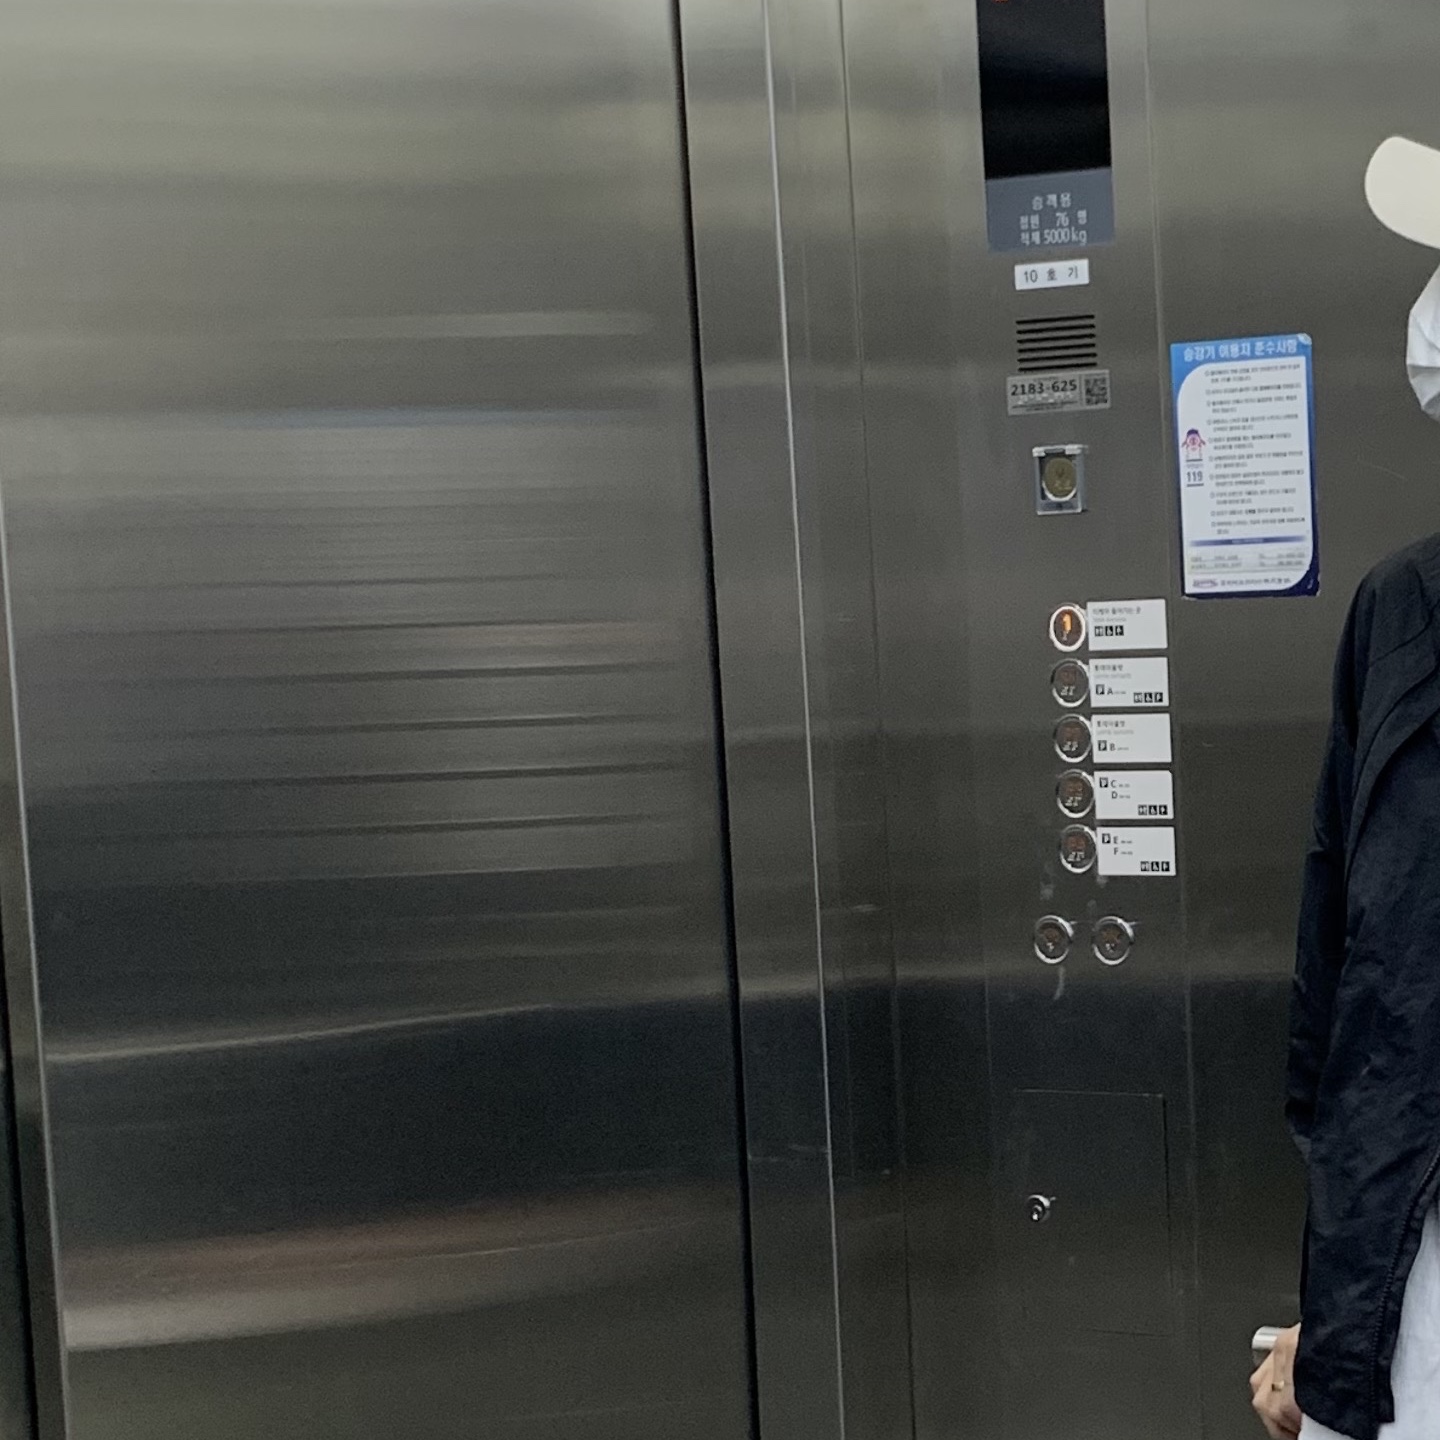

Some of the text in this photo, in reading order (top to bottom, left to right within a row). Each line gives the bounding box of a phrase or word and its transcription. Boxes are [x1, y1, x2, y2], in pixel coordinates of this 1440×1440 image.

[1055, 211, 1070, 227] 76
[1023, 269, 1038, 283] 10
[1011, 379, 1077, 396] 2183-625
